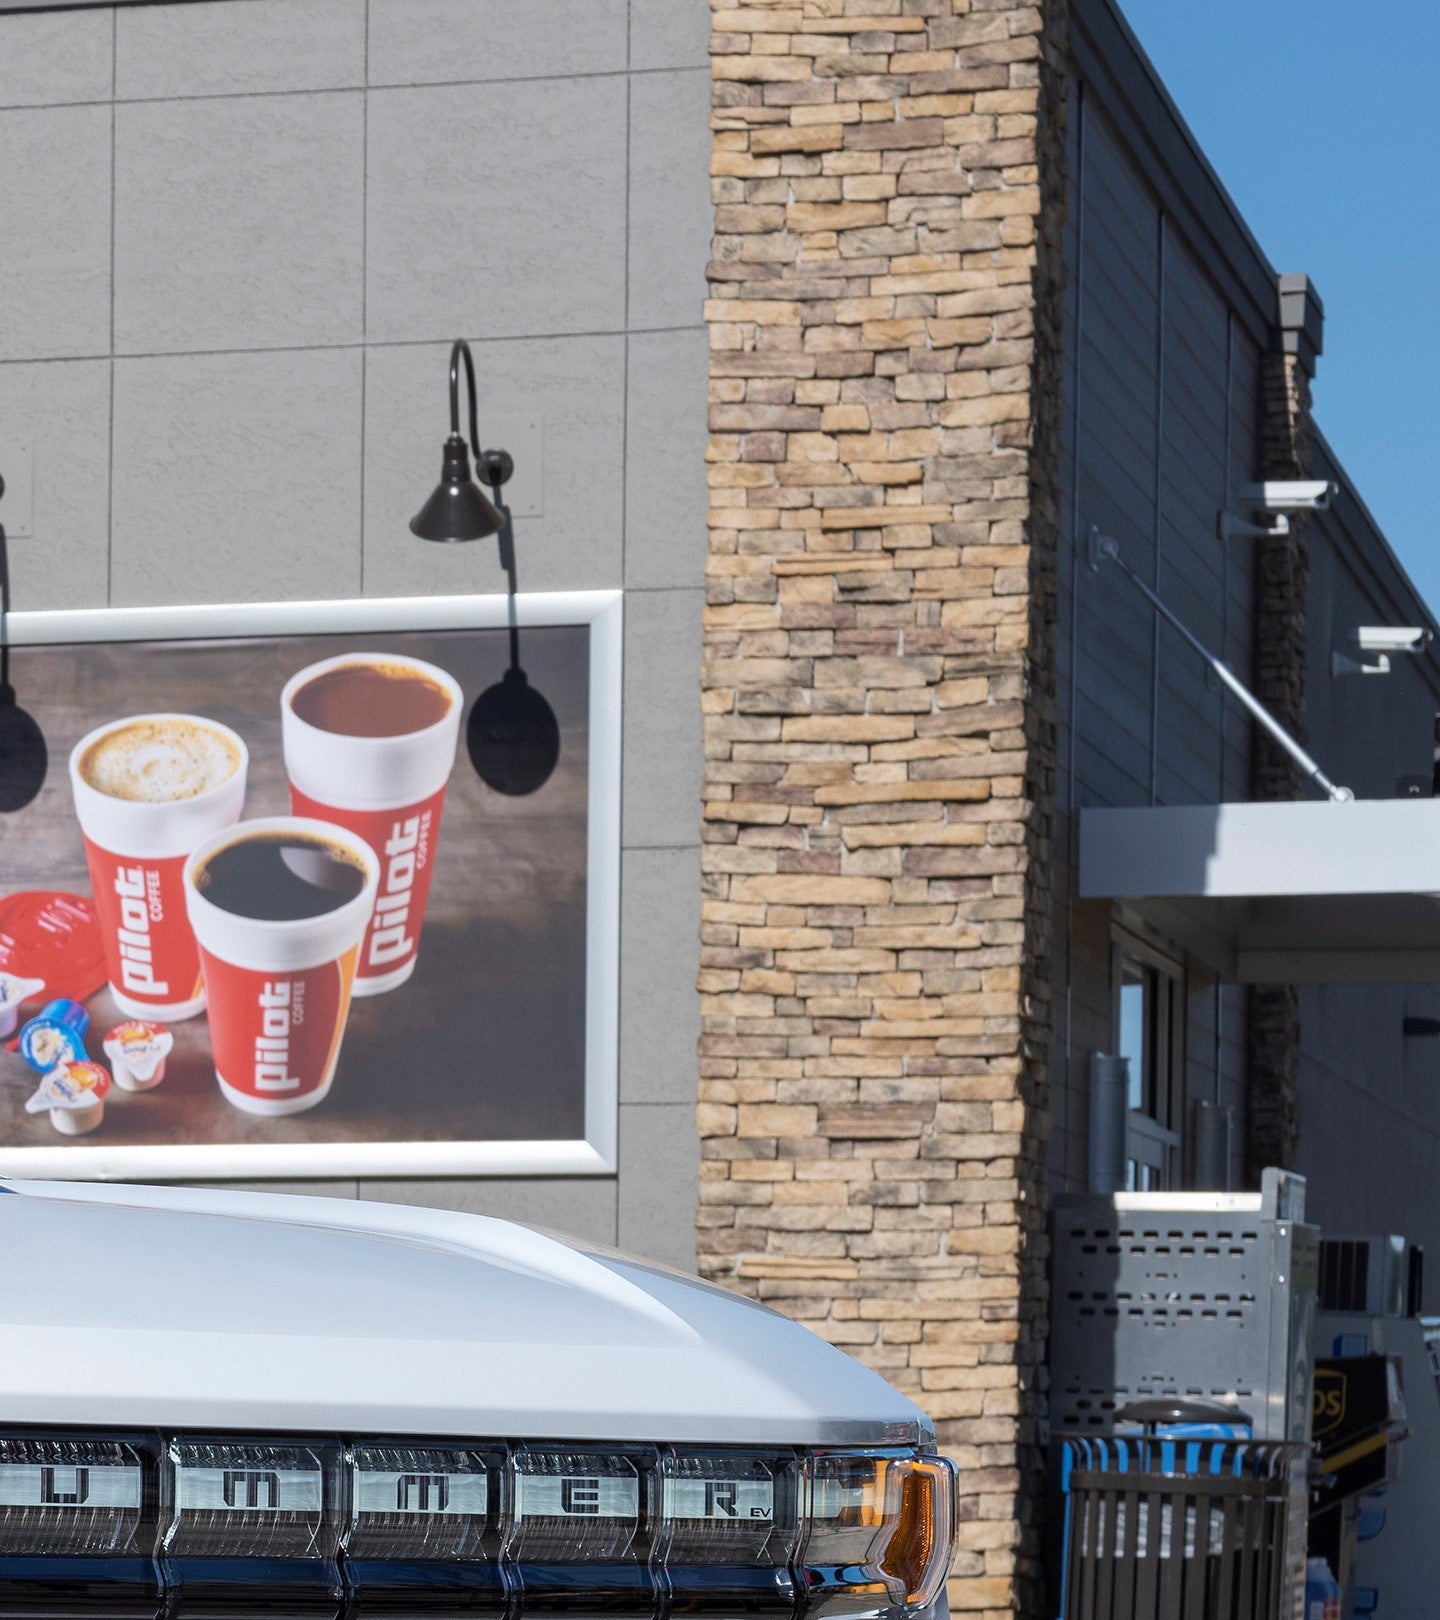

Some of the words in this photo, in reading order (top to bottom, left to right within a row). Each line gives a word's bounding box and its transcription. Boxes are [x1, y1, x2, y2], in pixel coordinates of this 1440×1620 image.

[415, 809, 433, 870] COFFEE
[145, 870, 164, 922] COFFEE
[292, 980, 306, 1025] COFFEE
[750, 1507, 771, 1518] EV
